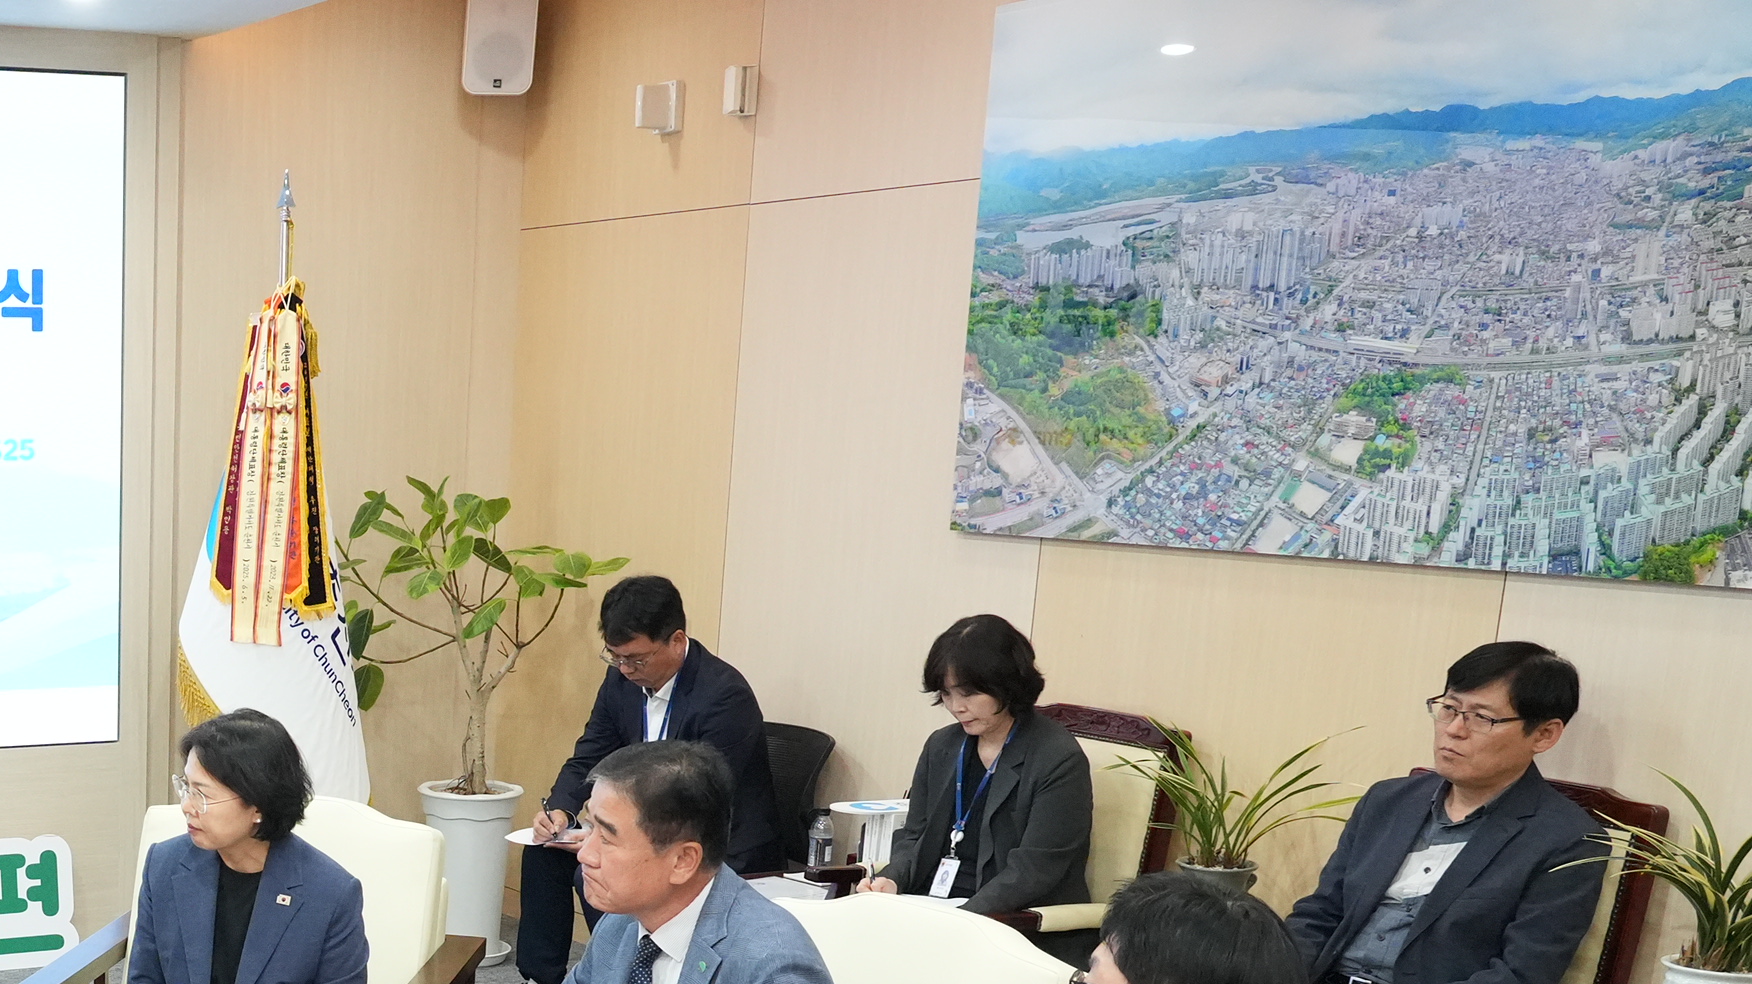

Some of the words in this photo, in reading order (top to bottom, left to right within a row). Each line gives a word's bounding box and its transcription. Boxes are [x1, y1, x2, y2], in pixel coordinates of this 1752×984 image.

[282, 606, 305, 628] ity
[301, 628, 319, 645] of
[313, 644, 357, 728] ChunCheon
